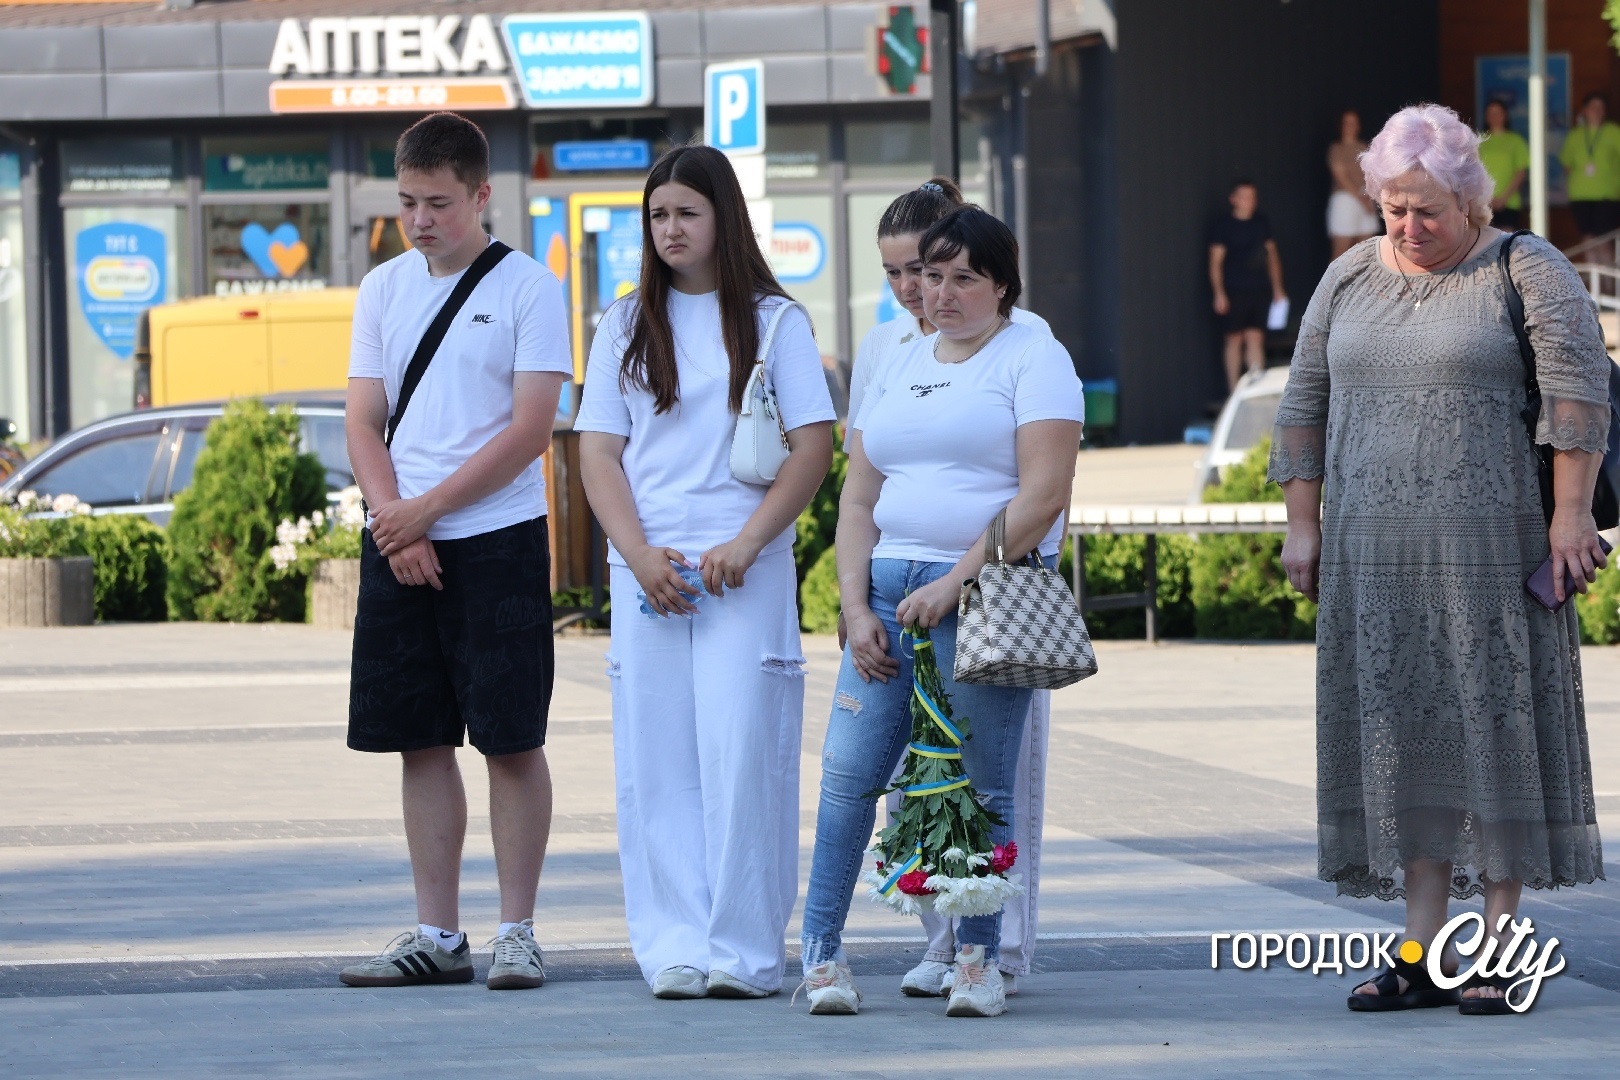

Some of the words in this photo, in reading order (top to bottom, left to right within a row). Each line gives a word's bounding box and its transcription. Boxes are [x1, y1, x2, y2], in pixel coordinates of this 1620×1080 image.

[269, 14, 504, 74] АПТЕКА
[719, 74, 749, 145] P
[472, 314, 491, 323] NIKE
[911, 381, 951, 391] CHANEL
